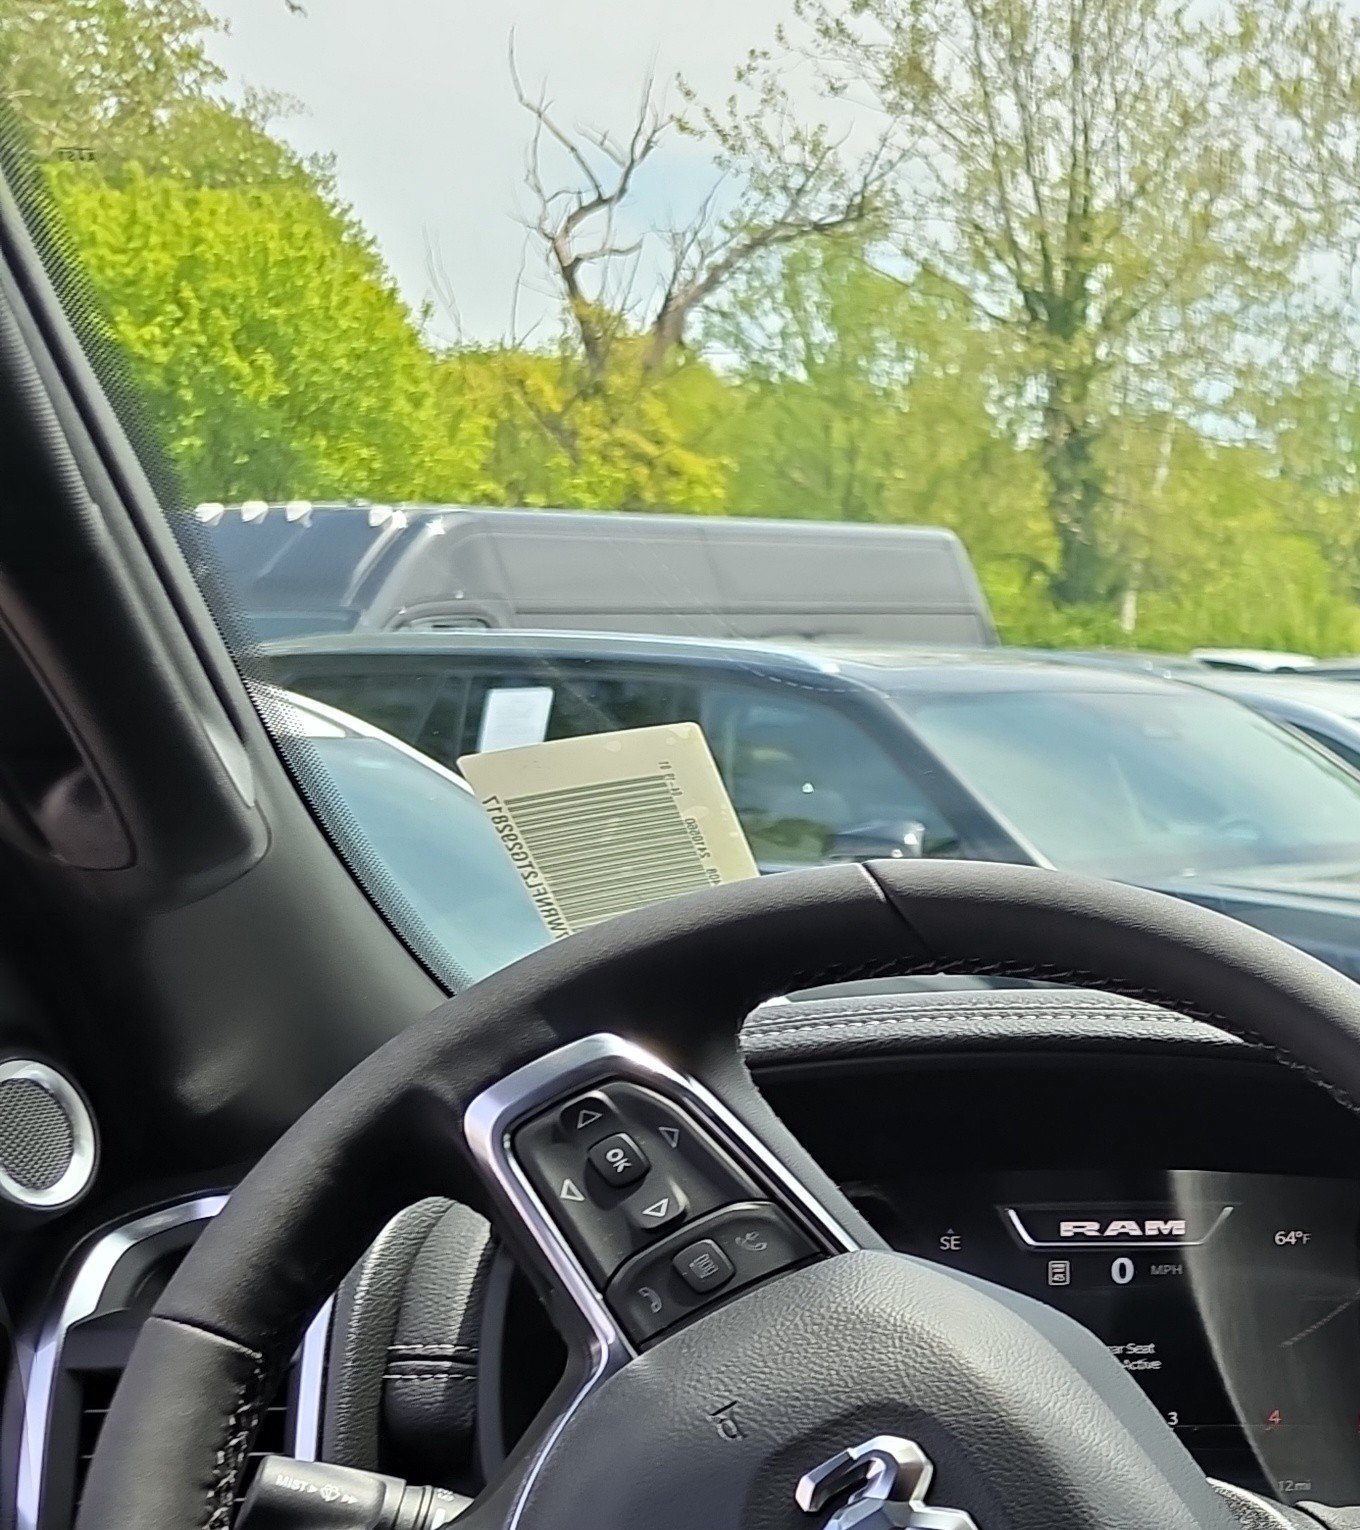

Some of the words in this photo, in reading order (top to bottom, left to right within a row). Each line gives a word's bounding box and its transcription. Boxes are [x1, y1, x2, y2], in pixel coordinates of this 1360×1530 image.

[606, 1148, 631, 1174] OK
[1059, 1220, 1186, 1237] RAM
[940, 1235, 961, 1250] SE
[1274, 1231, 1312, 1245] 64°F
[1111, 1258, 1134, 1284] 0
[1150, 1264, 1183, 1276] MPH
[1126, 1343, 1155, 1354] Seat
[1168, 1412, 1178, 1425] 3
[1268, 1409, 1281, 1426] 4
[275, 1474, 308, 1492] MIST
